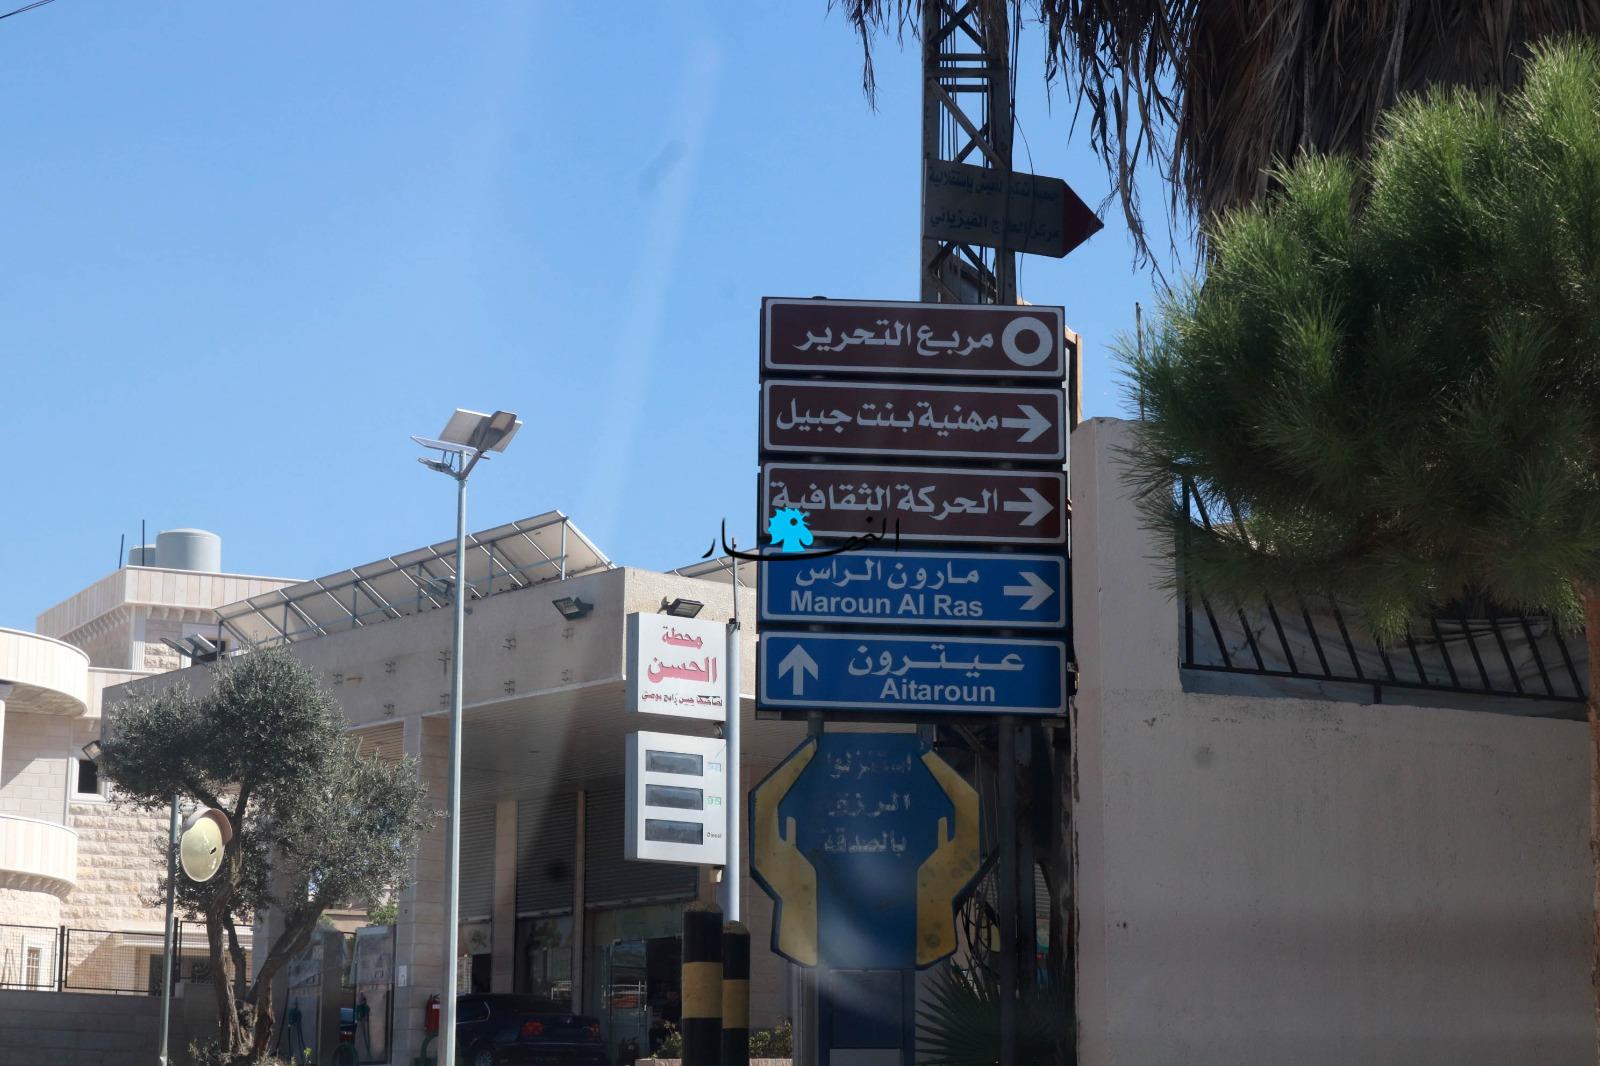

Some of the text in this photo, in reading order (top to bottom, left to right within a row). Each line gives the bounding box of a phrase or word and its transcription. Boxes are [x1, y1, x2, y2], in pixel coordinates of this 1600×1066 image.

[792, 318, 994, 357] مربع التحرير
[776, 397, 999, 438] مهنية بنت جبيل
[769, 480, 999, 520] الحركة الثقافية
[795, 557, 980, 590] مارون الراس
[790, 590, 984, 617] Maroun Al Ras
[661, 625, 704, 650] محطة
[647, 655, 718, 684] الحسن
[848, 643, 1025, 679] عيترون
[879, 678, 996, 703] Aitaroun
